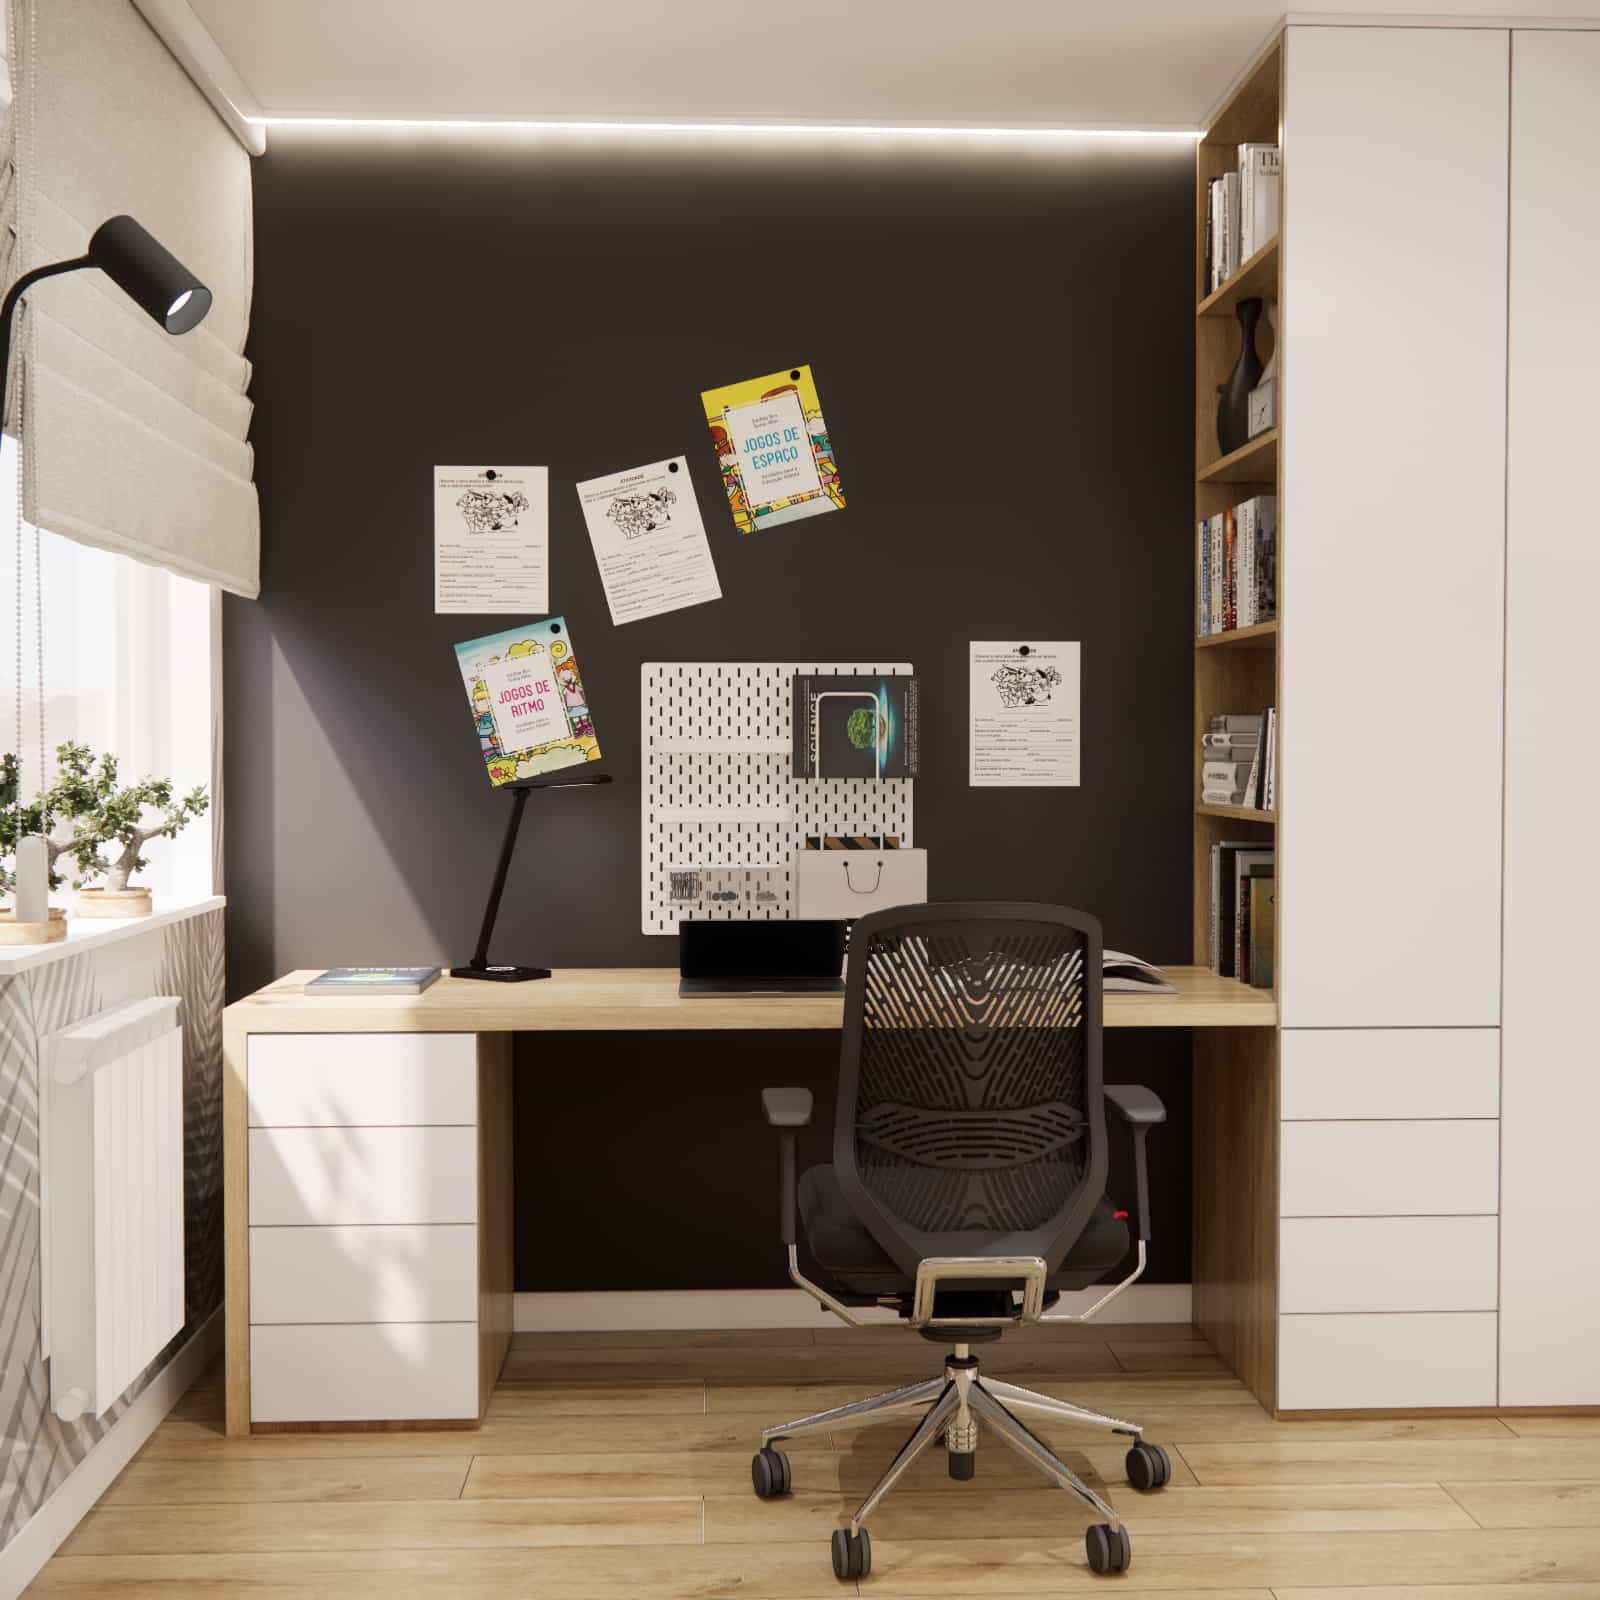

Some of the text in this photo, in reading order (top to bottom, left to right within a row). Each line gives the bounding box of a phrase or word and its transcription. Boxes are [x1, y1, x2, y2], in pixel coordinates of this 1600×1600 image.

[744, 427, 800, 453] JOGOS DE
[752, 447, 798, 470] ESPAÇO
[499, 679, 550, 704] JOGOS DE
[511, 698, 544, 718] RITMO
